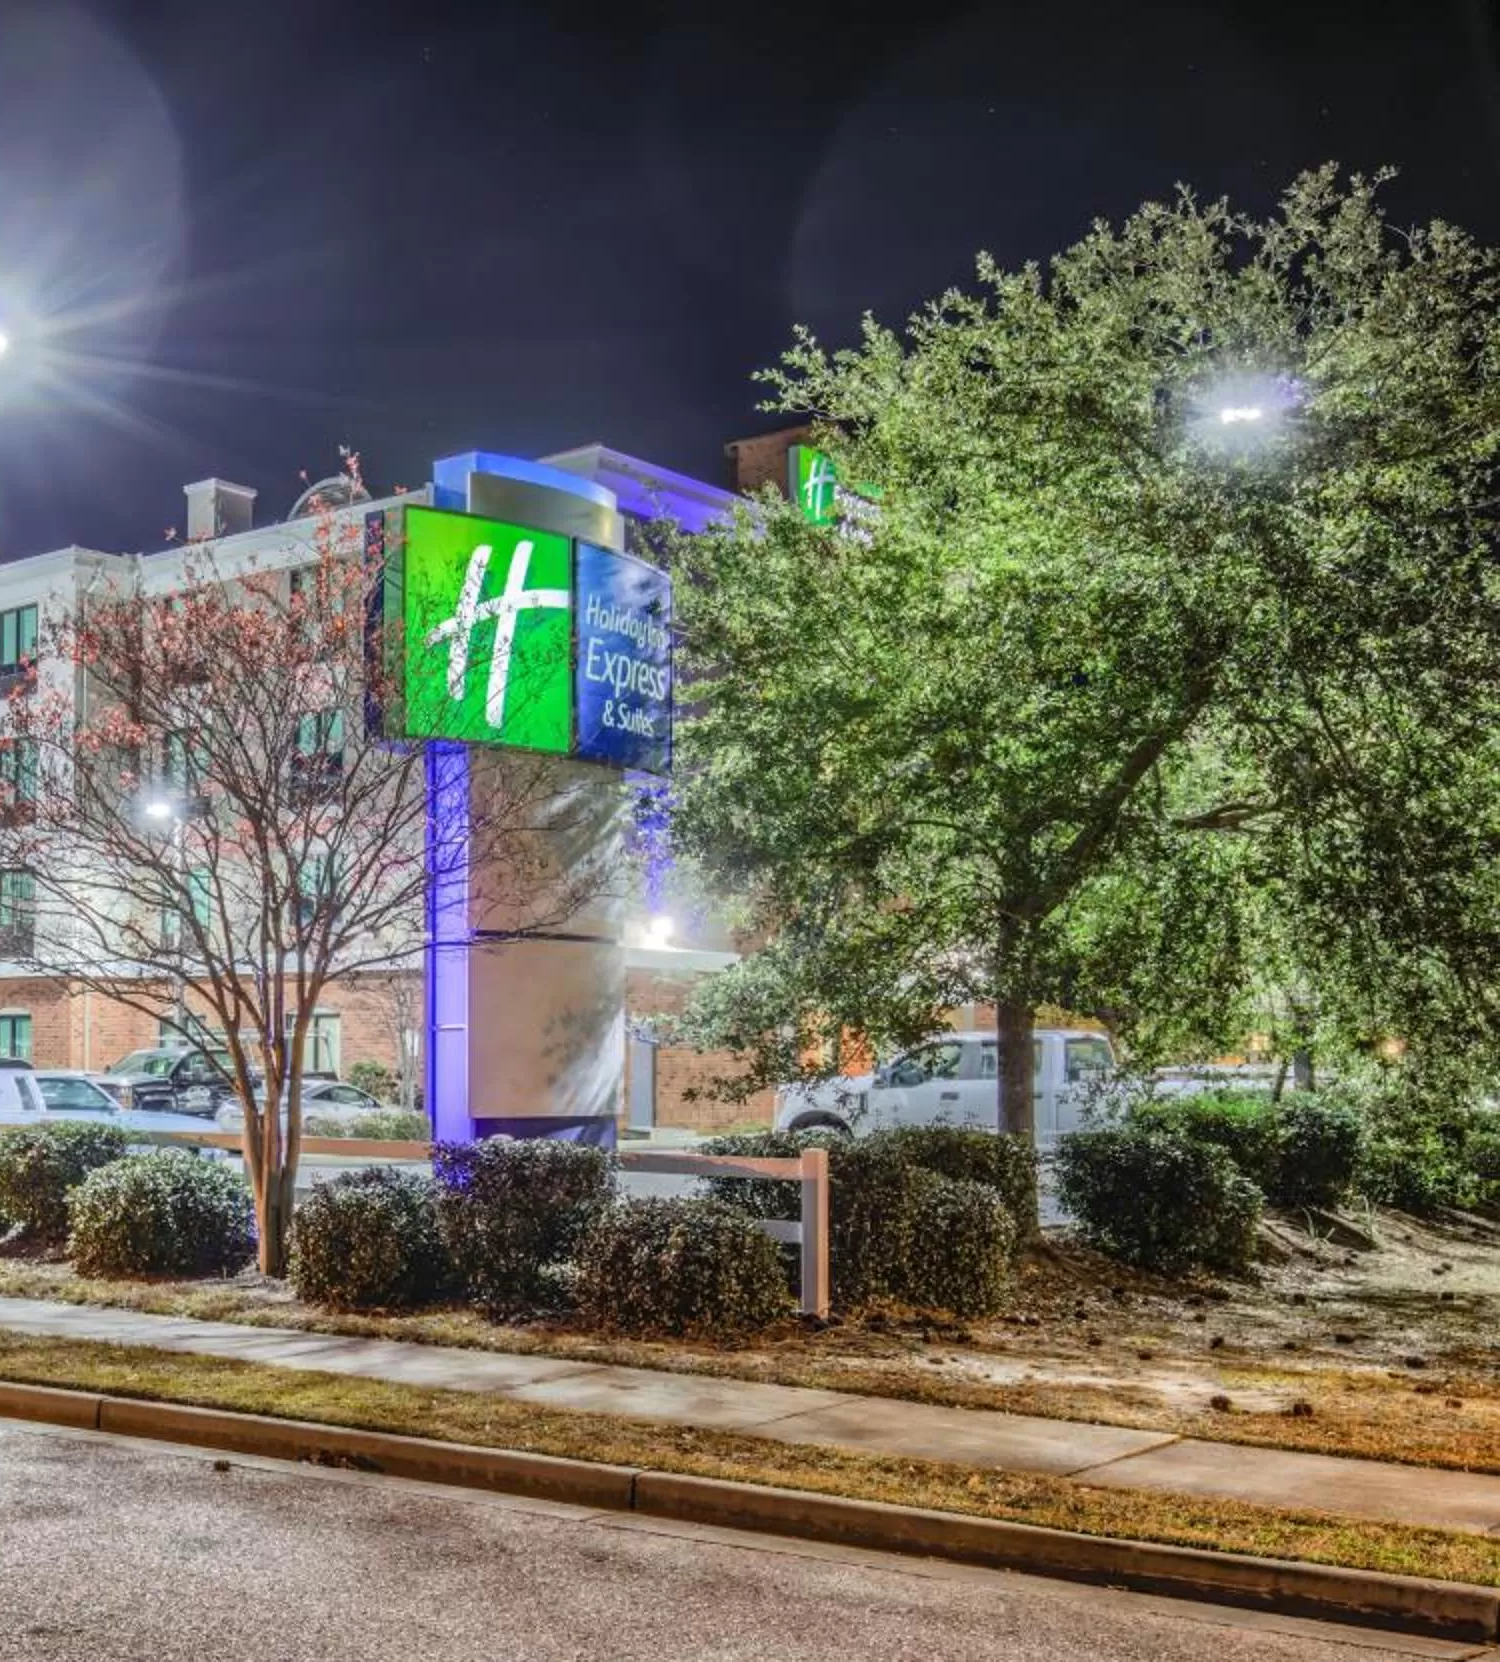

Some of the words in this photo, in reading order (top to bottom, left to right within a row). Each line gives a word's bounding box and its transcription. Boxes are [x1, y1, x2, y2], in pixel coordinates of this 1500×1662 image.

[424, 540, 569, 729] H
[585, 593, 646, 649] Holiday
[585, 636, 665, 701] Express
[602, 699, 614, 728] &
[617, 702, 655, 737] Suites
